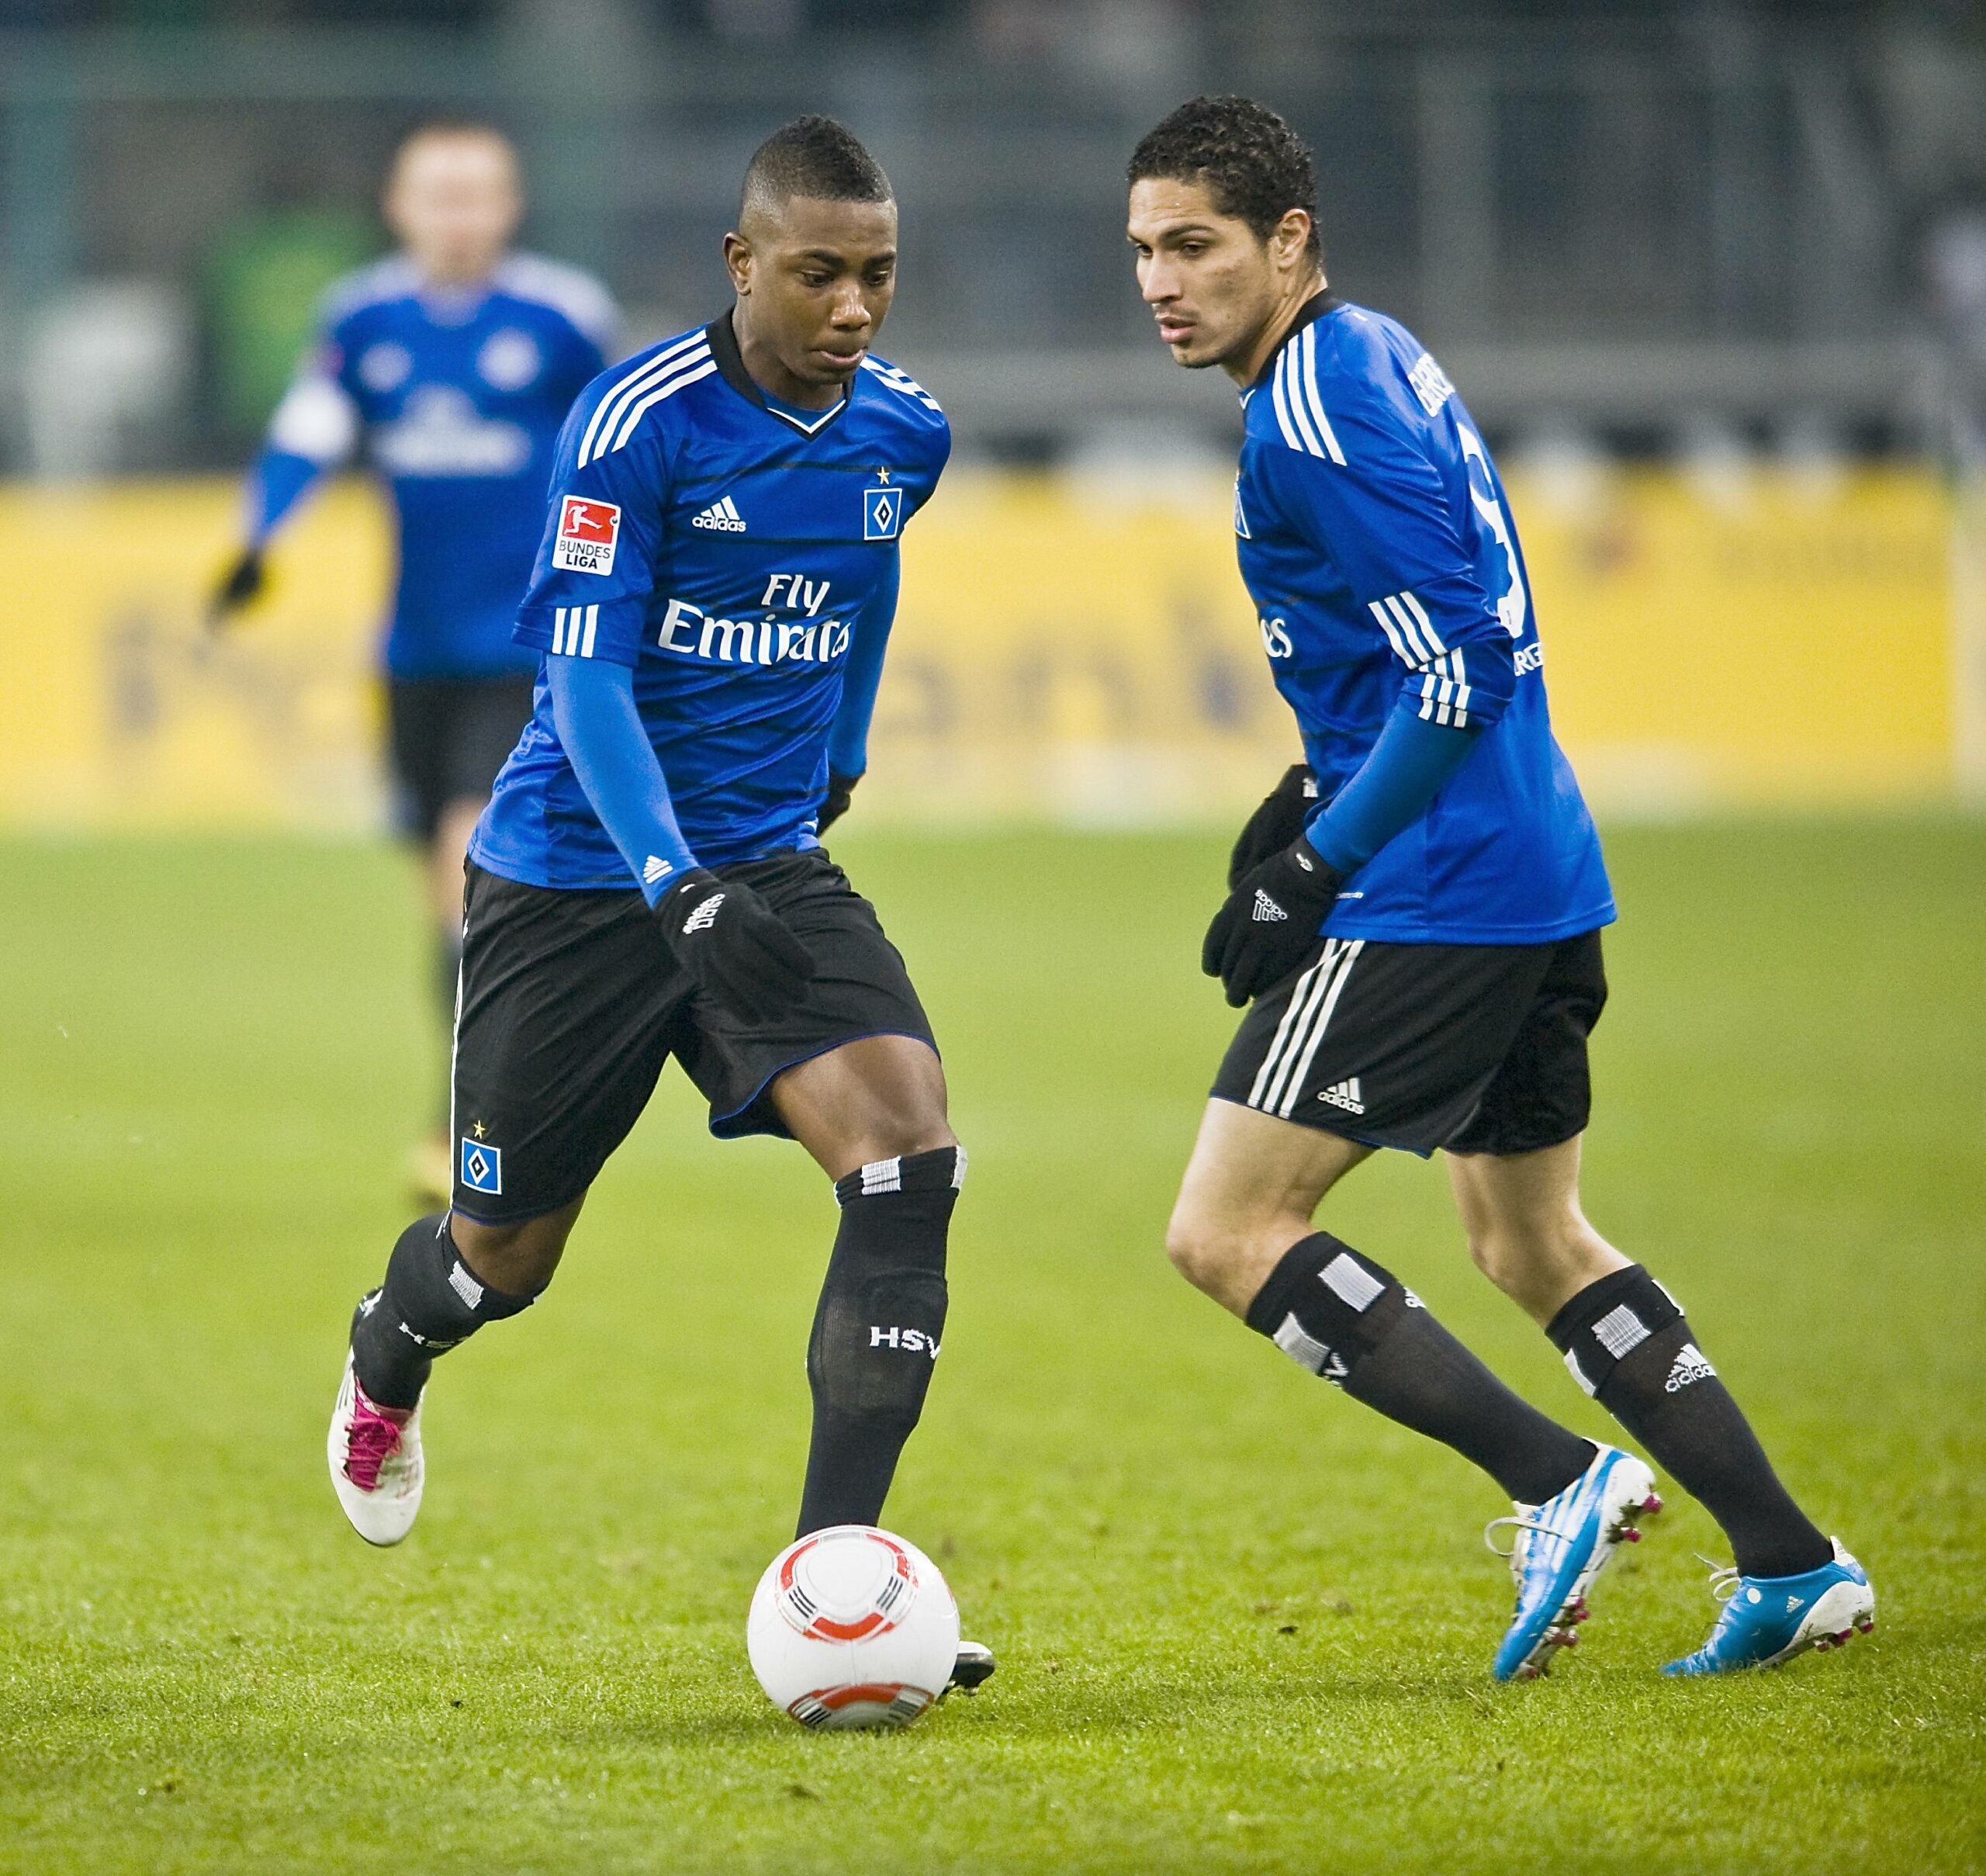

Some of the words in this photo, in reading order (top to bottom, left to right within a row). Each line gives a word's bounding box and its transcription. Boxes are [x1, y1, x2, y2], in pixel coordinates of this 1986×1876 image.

[692, 517, 746, 533] adidas
[559, 540, 611, 559] BUNDES
[566, 553, 598, 570] LIGA
[767, 574, 830, 618] Fly
[1317, 1091, 1365, 1115] adidas
[869, 1326, 941, 1360] HSV
